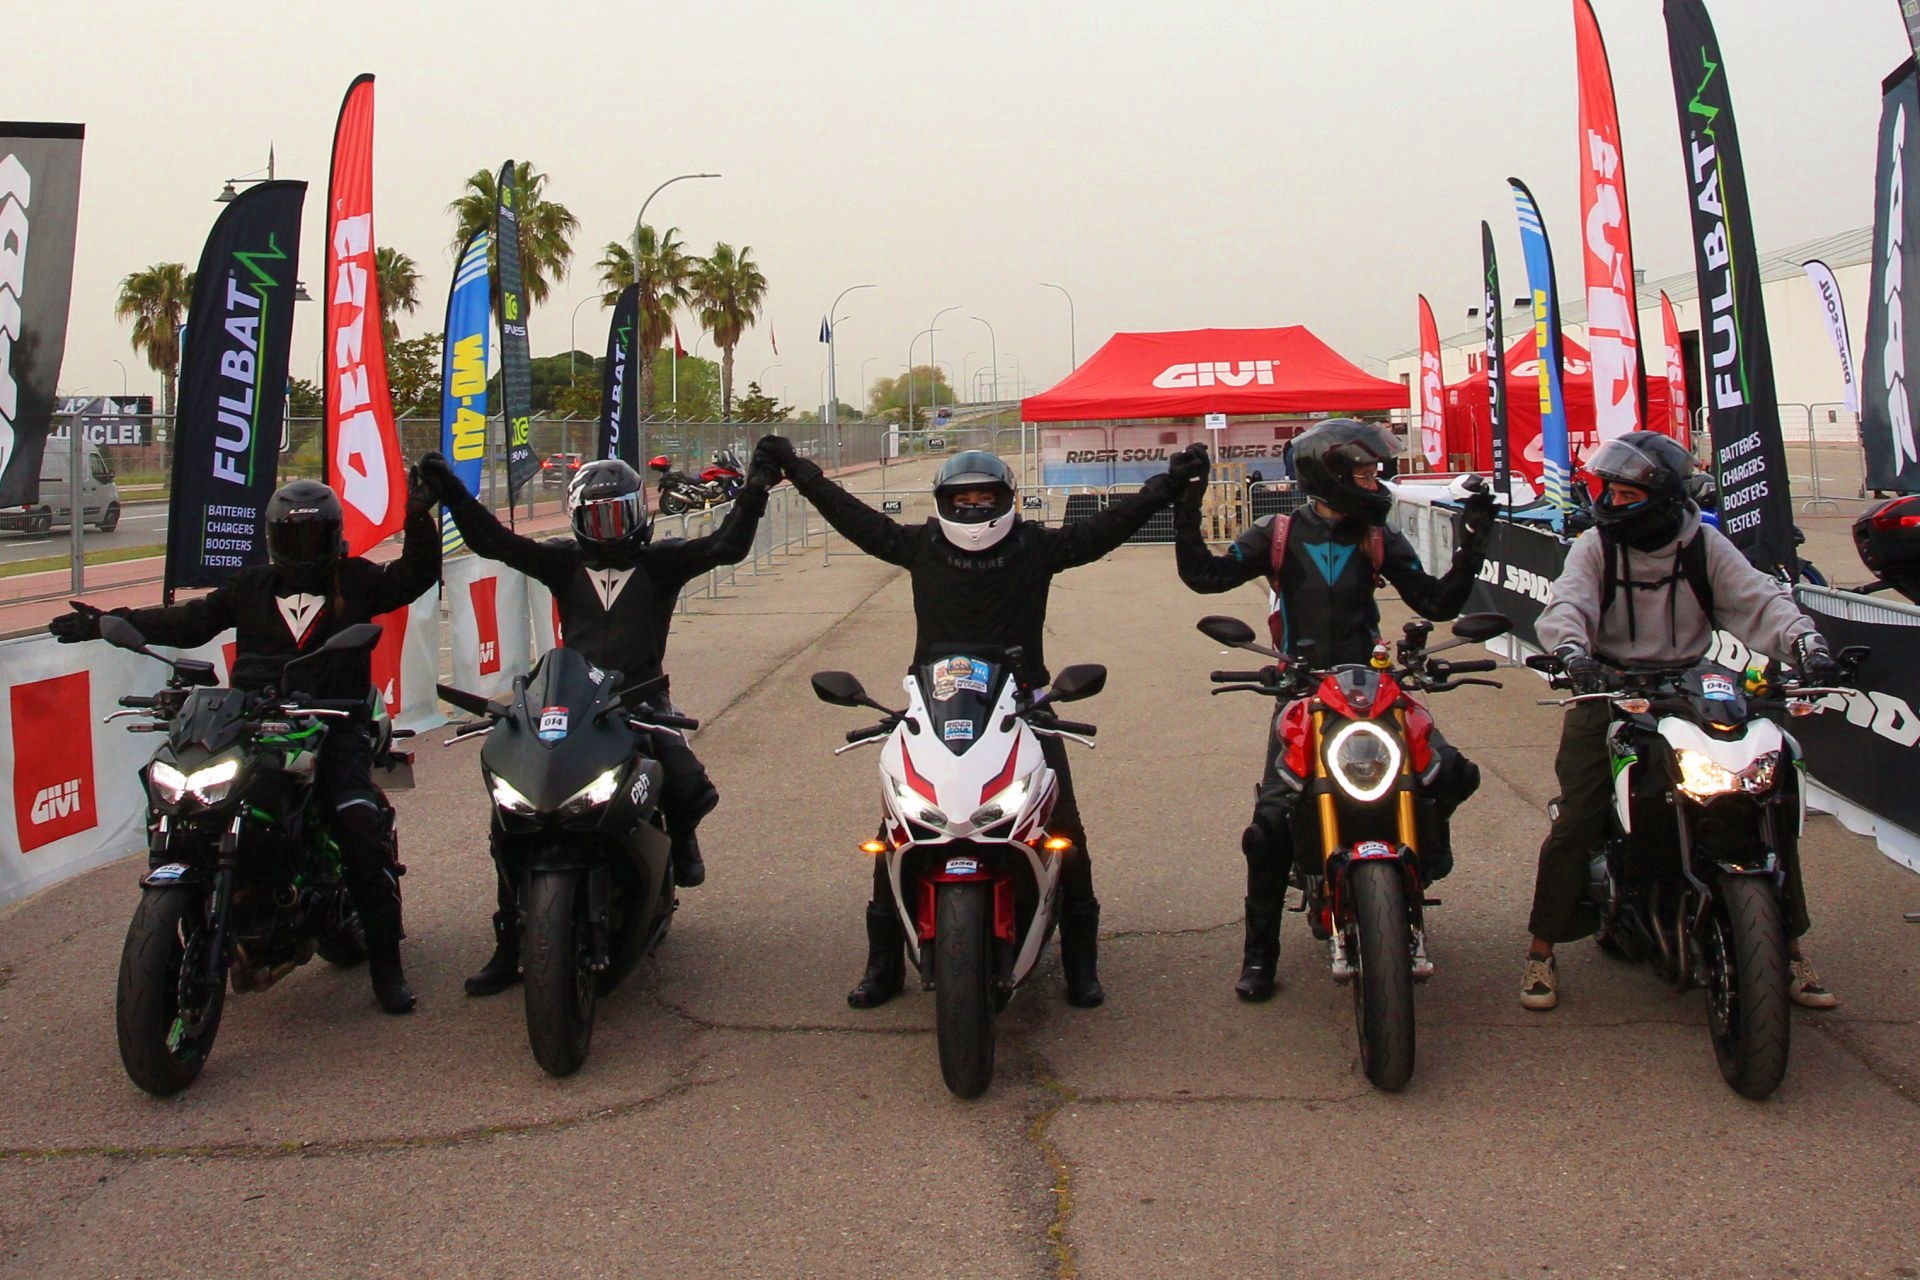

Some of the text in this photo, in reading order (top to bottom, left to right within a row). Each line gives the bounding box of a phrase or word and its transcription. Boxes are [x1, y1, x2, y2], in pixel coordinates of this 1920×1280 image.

[1692, 141, 1744, 410] FULBAT
[212, 277, 261, 486] FULBAT
[1153, 360, 1274, 389] GIVI
[451, 333, 487, 462] WD-40
[608, 343, 627, 460] FULBAT
[1066, 449, 1168, 464] RIDER SOUL
[1720, 431, 1762, 463] BATTERIES
[1722, 455, 1765, 488] CHARGERS
[1725, 479, 1768, 511] BOOSTERS
[208, 505, 256, 518] BATTERIES
[1726, 507, 1761, 536] TESTERS
[207, 522, 254, 535] CHARGERS
[205, 538, 252, 551] BOOSTERS
[204, 555, 242, 567] TESTERS
[544, 718, 563, 727] 014
[30, 778, 80, 825] GIVI
